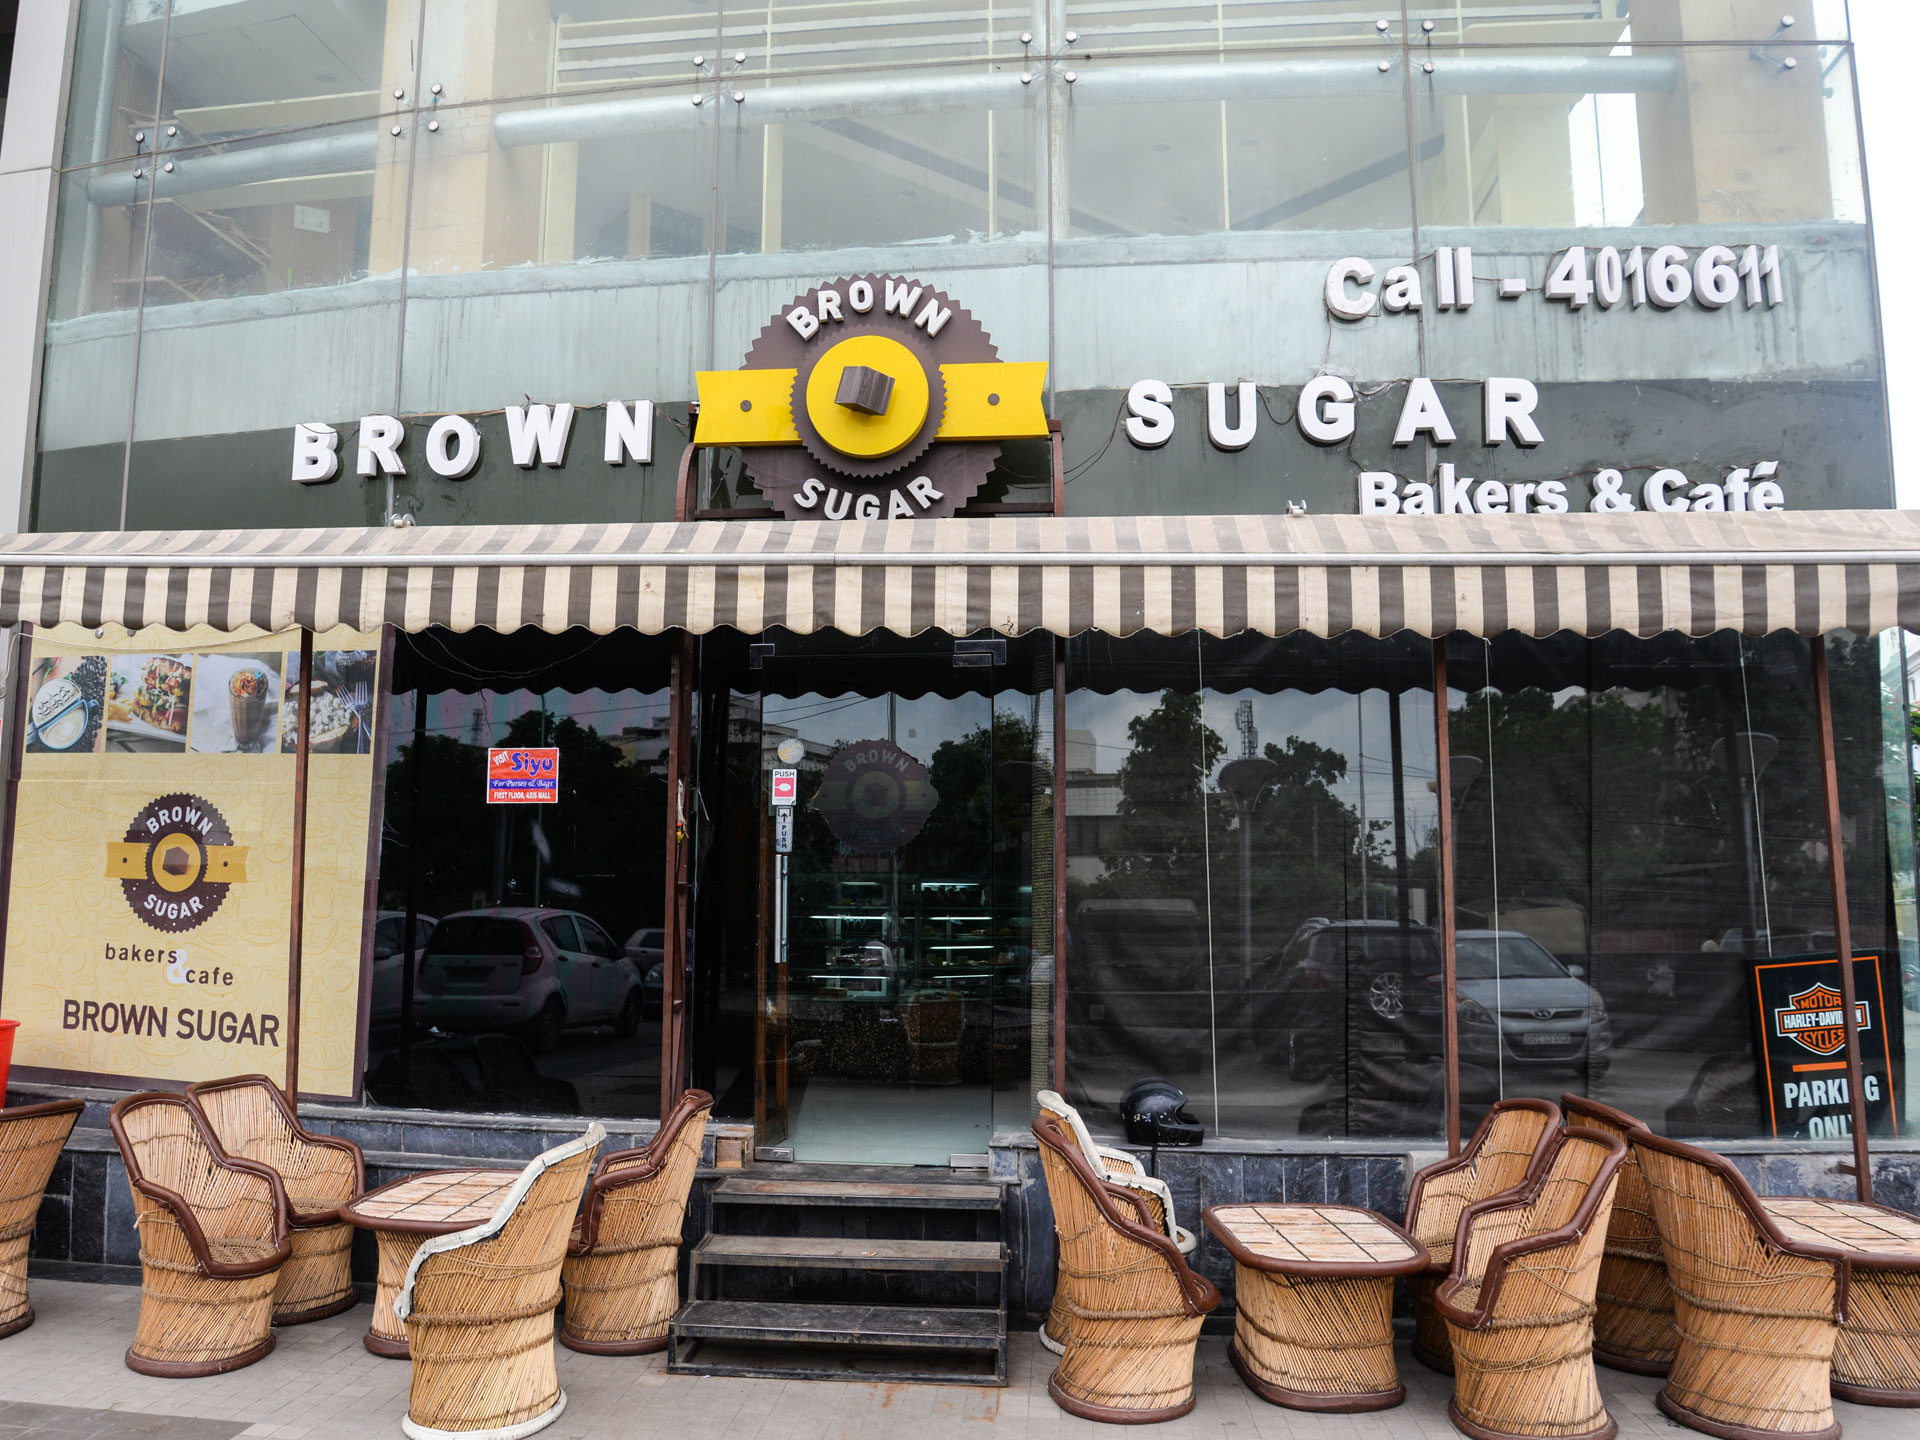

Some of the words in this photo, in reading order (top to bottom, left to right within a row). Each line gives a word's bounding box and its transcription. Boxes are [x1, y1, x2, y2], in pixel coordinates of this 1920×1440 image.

[1325, 246, 1474, 320] Call
[1545, 245, 1784, 309] 4016611
[786, 279, 952, 342] BROWN
[291, 400, 652, 482] BROWN
[1125, 376, 1546, 449] SUGAR
[793, 475, 944, 521] SUGAR
[1358, 463, 1570, 515] Bakers
[1590, 468, 1637, 513] &
[1644, 460, 1786, 513] Café
[493, 751, 510, 766] VISIT
[511, 752, 553, 776] Siyu
[843, 751, 909, 773] BROWN
[536, 780, 553, 789] Bags
[146, 806, 213, 836] BROWN
[144, 894, 204, 919] SUGAR
[105, 943, 177, 964] bakers
[185, 967, 234, 985] cafe
[1800, 992, 1842, 1009] MOTOR
[62, 999, 168, 1038] BROWN
[176, 1008, 280, 1047] SUGAR
[1783, 1010, 1862, 1029] HARLEY-DAVIDN
[1803, 1029, 1845, 1048] CYCLES
[1783, 1075, 1880, 1108] PARKIG
